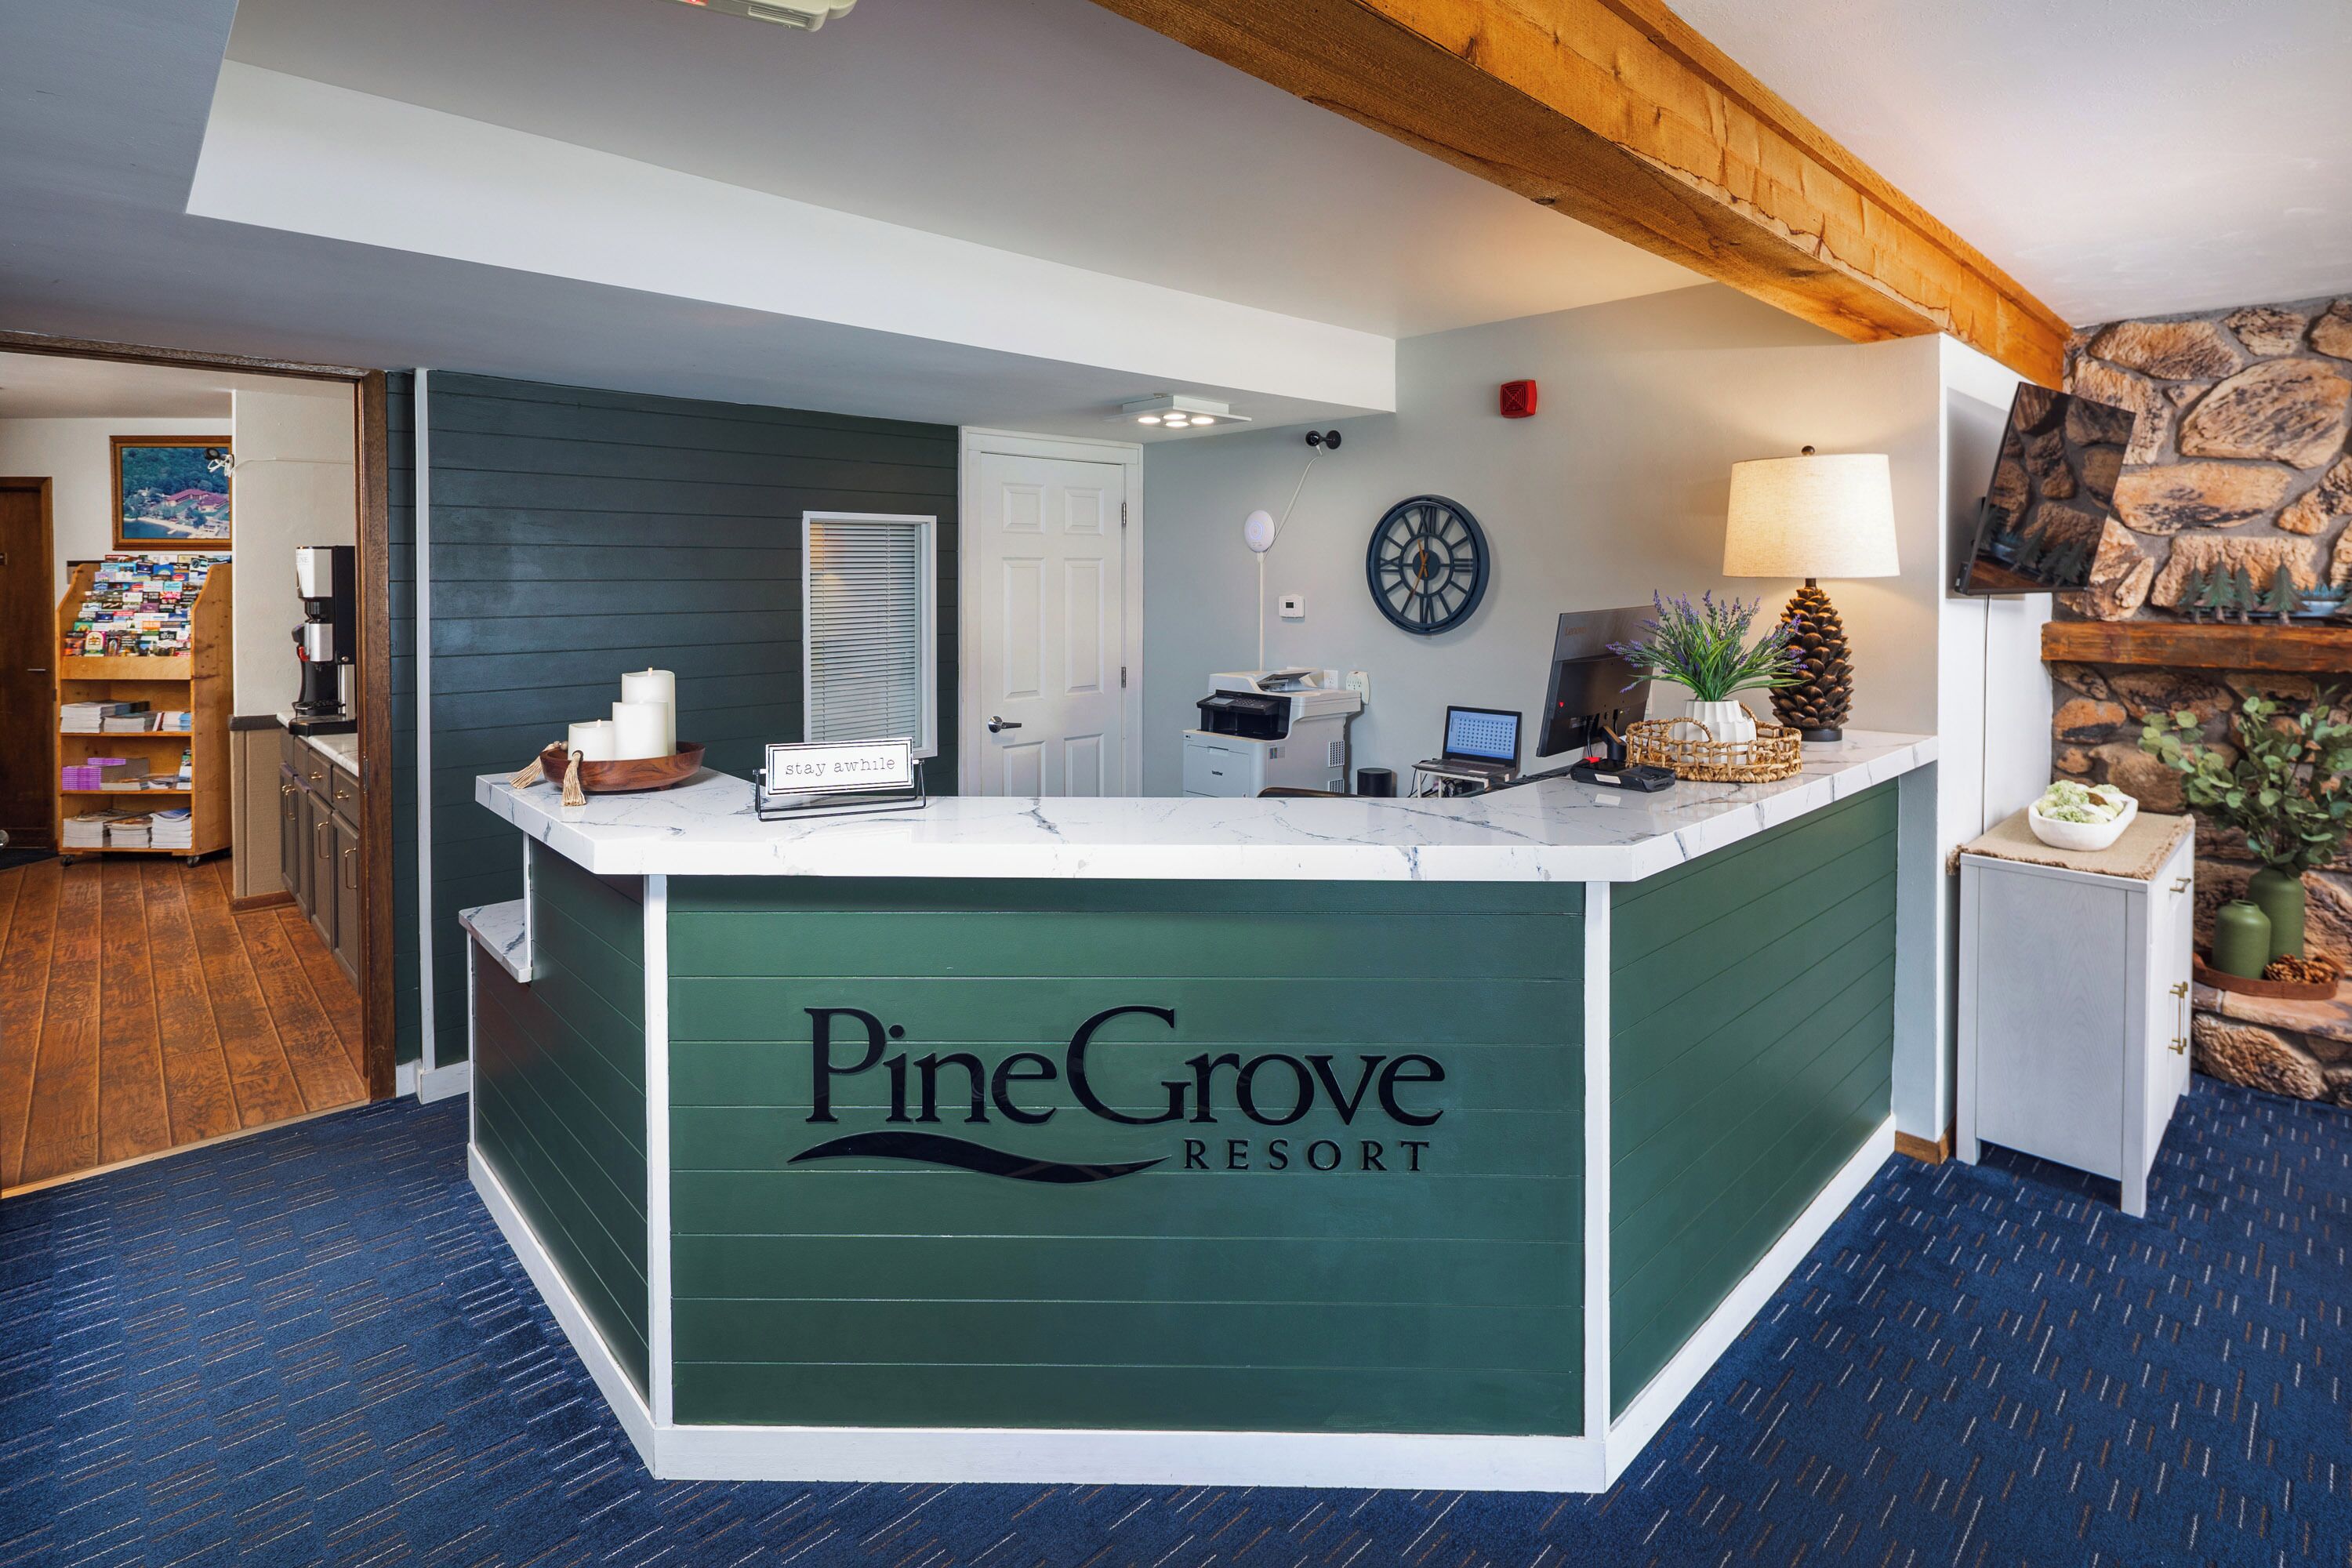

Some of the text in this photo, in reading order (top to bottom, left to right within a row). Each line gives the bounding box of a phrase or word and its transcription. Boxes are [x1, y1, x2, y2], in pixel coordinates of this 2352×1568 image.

[786, 757, 895, 776] stay awhile
[804, 1004, 1446, 1126] PineGrove
[1182, 1138, 1430, 1172] RESORT
